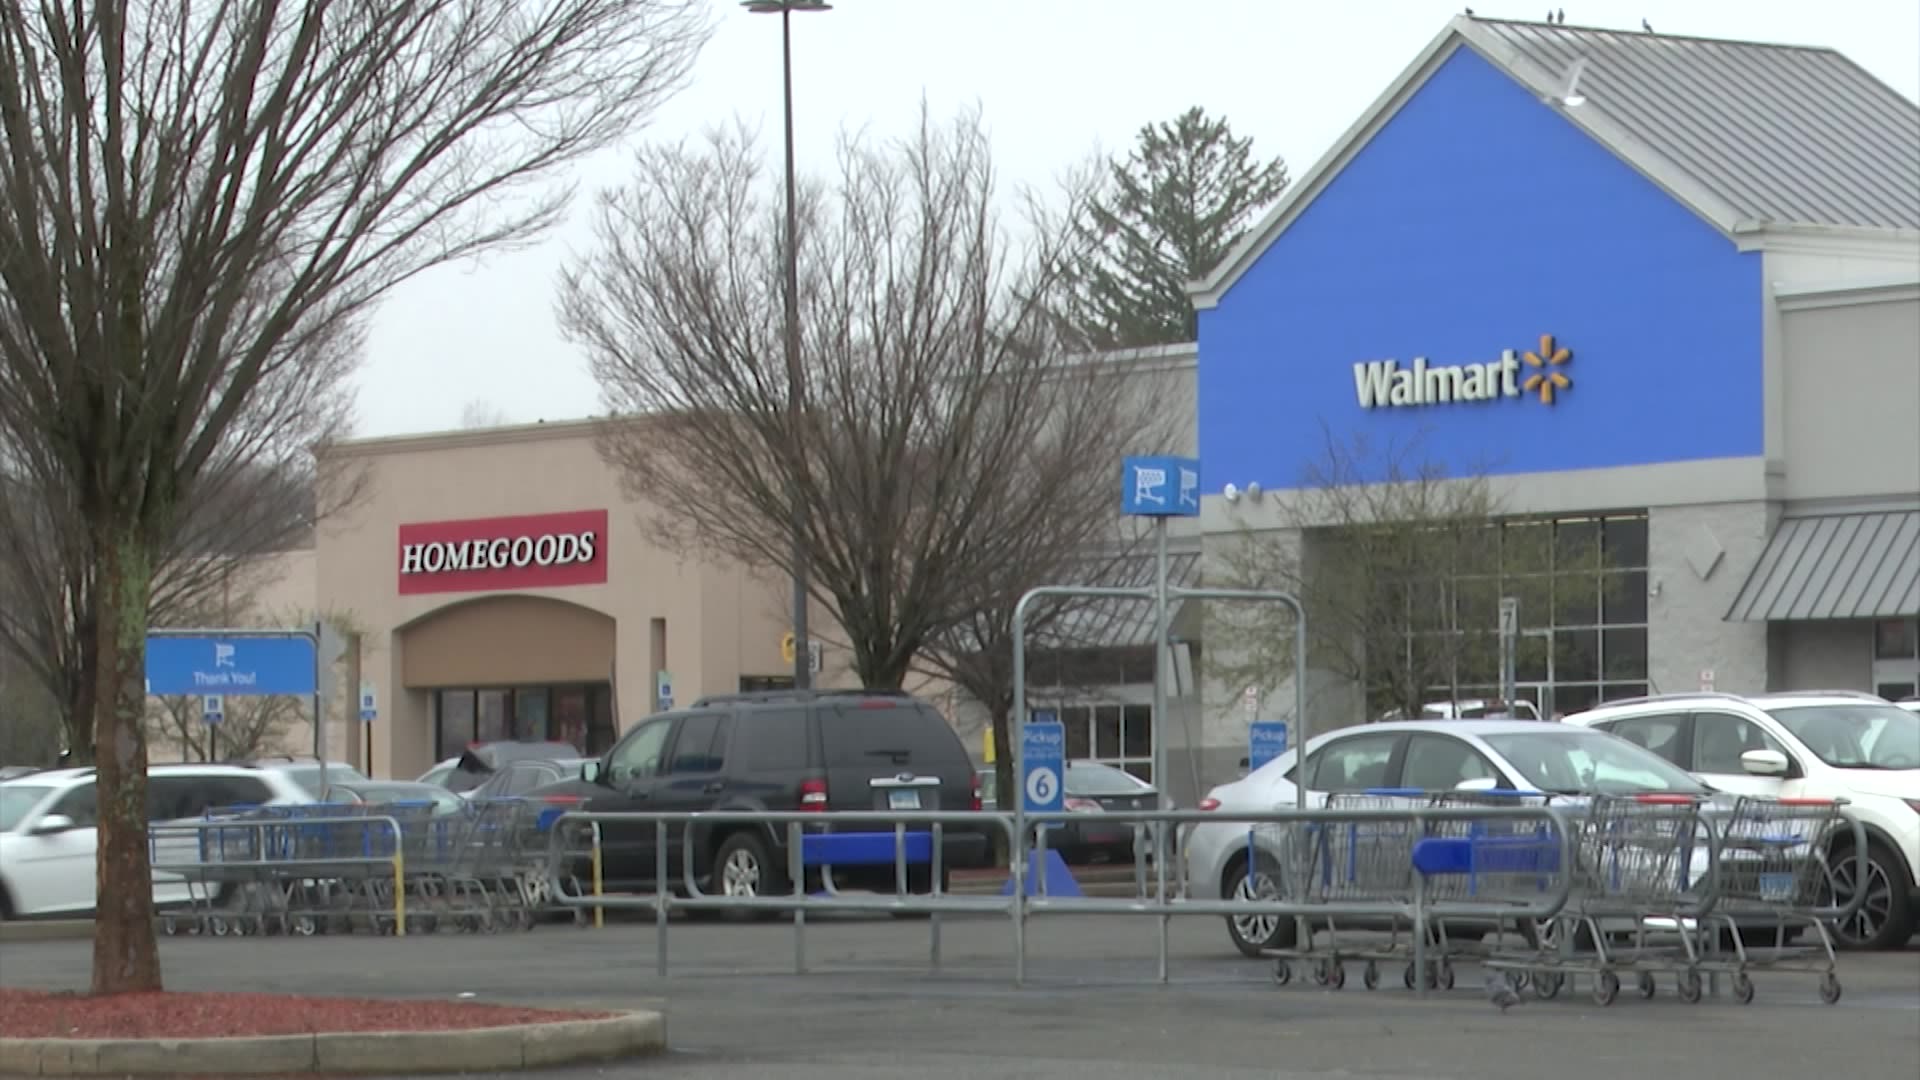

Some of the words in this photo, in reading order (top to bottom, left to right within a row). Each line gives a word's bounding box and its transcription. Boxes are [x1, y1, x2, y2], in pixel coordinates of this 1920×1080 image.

[1353, 349, 1519, 408] Walmart
[401, 531, 596, 573] HOMEGOODS
[193, 671, 228, 686] Thank
[230, 671, 257, 686] You!
[1036, 774, 1050, 799] 6
